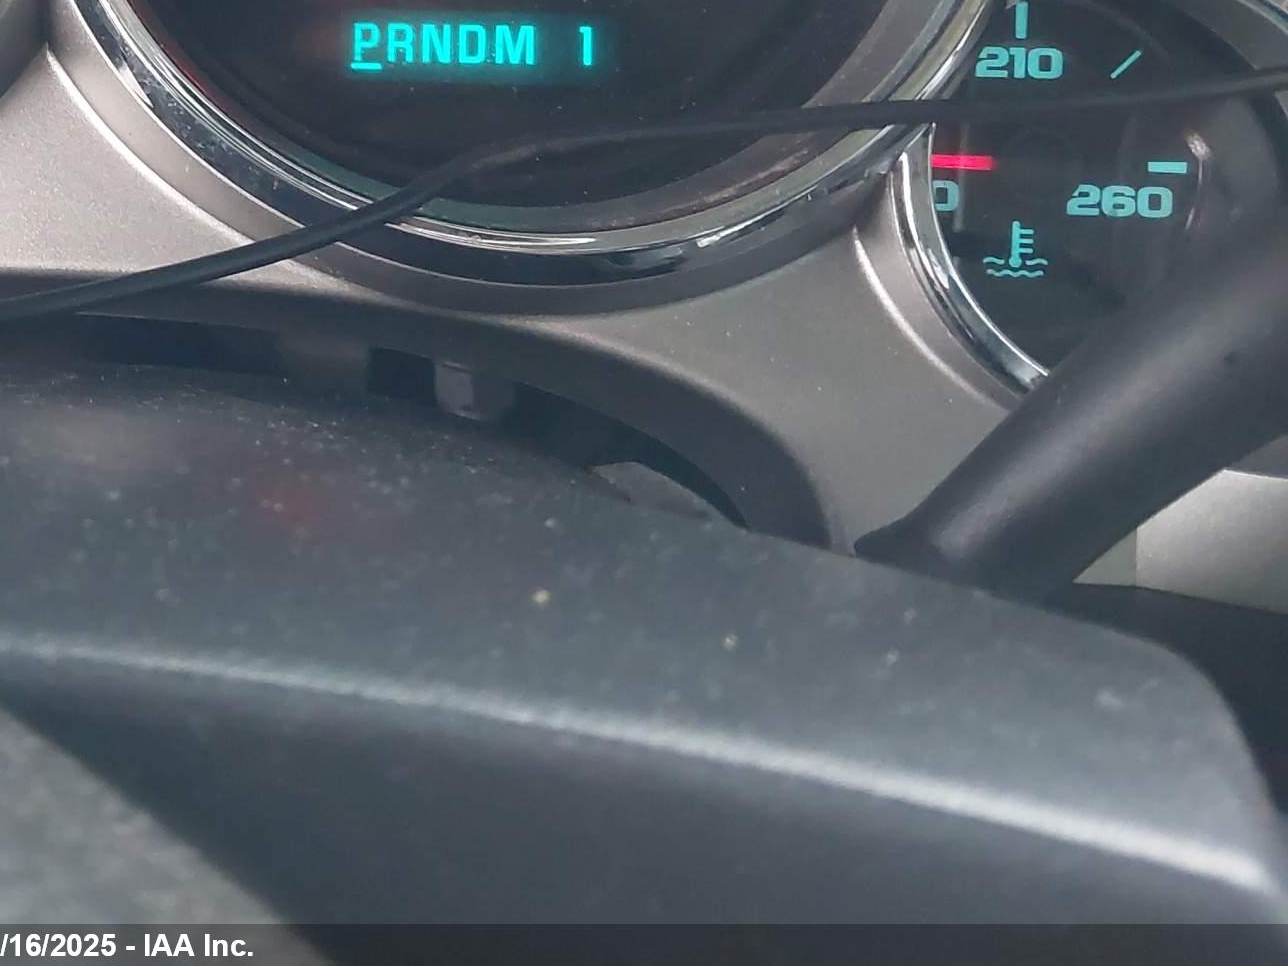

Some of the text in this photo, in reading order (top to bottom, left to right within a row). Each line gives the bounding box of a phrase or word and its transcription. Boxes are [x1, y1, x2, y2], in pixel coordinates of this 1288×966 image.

[352, 22, 535, 67] PRNDM
[975, 46, 1063, 79] 210
[1066, 184, 1173, 218] 260
